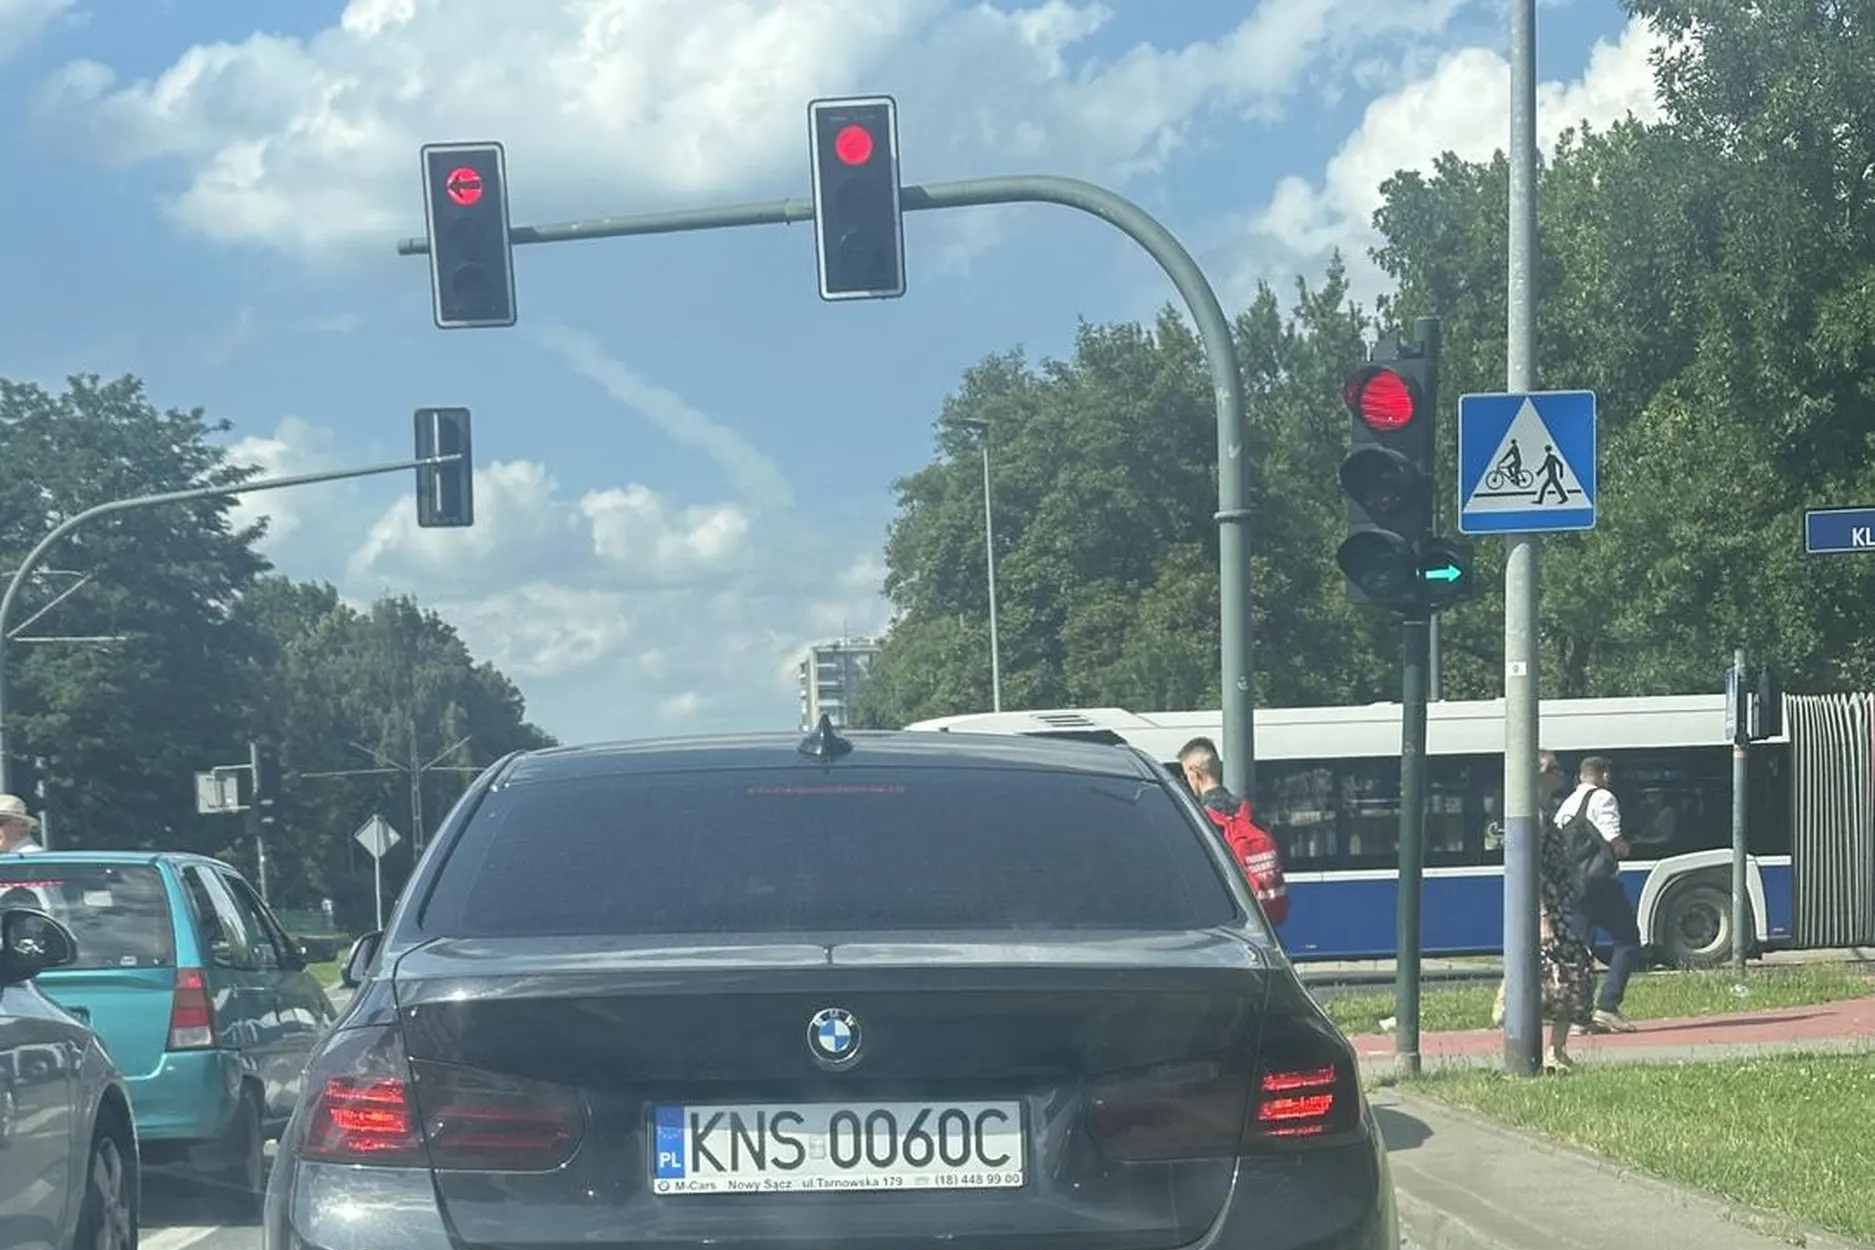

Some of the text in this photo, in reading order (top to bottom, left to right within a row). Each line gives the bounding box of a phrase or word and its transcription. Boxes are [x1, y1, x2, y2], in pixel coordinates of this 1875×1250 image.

[690, 1108, 1011, 1172] KNS 0060C
[659, 1151, 682, 1168] PL
[728, 1180, 761, 1192] Nowy
[763, 1178, 792, 1191] Sącz
[883, 1176, 904, 1187] 179
[935, 1174, 958, 1186] (18)
[986, 1173, 1001, 1185] 99
[1004, 1173, 1019, 1184] 00
